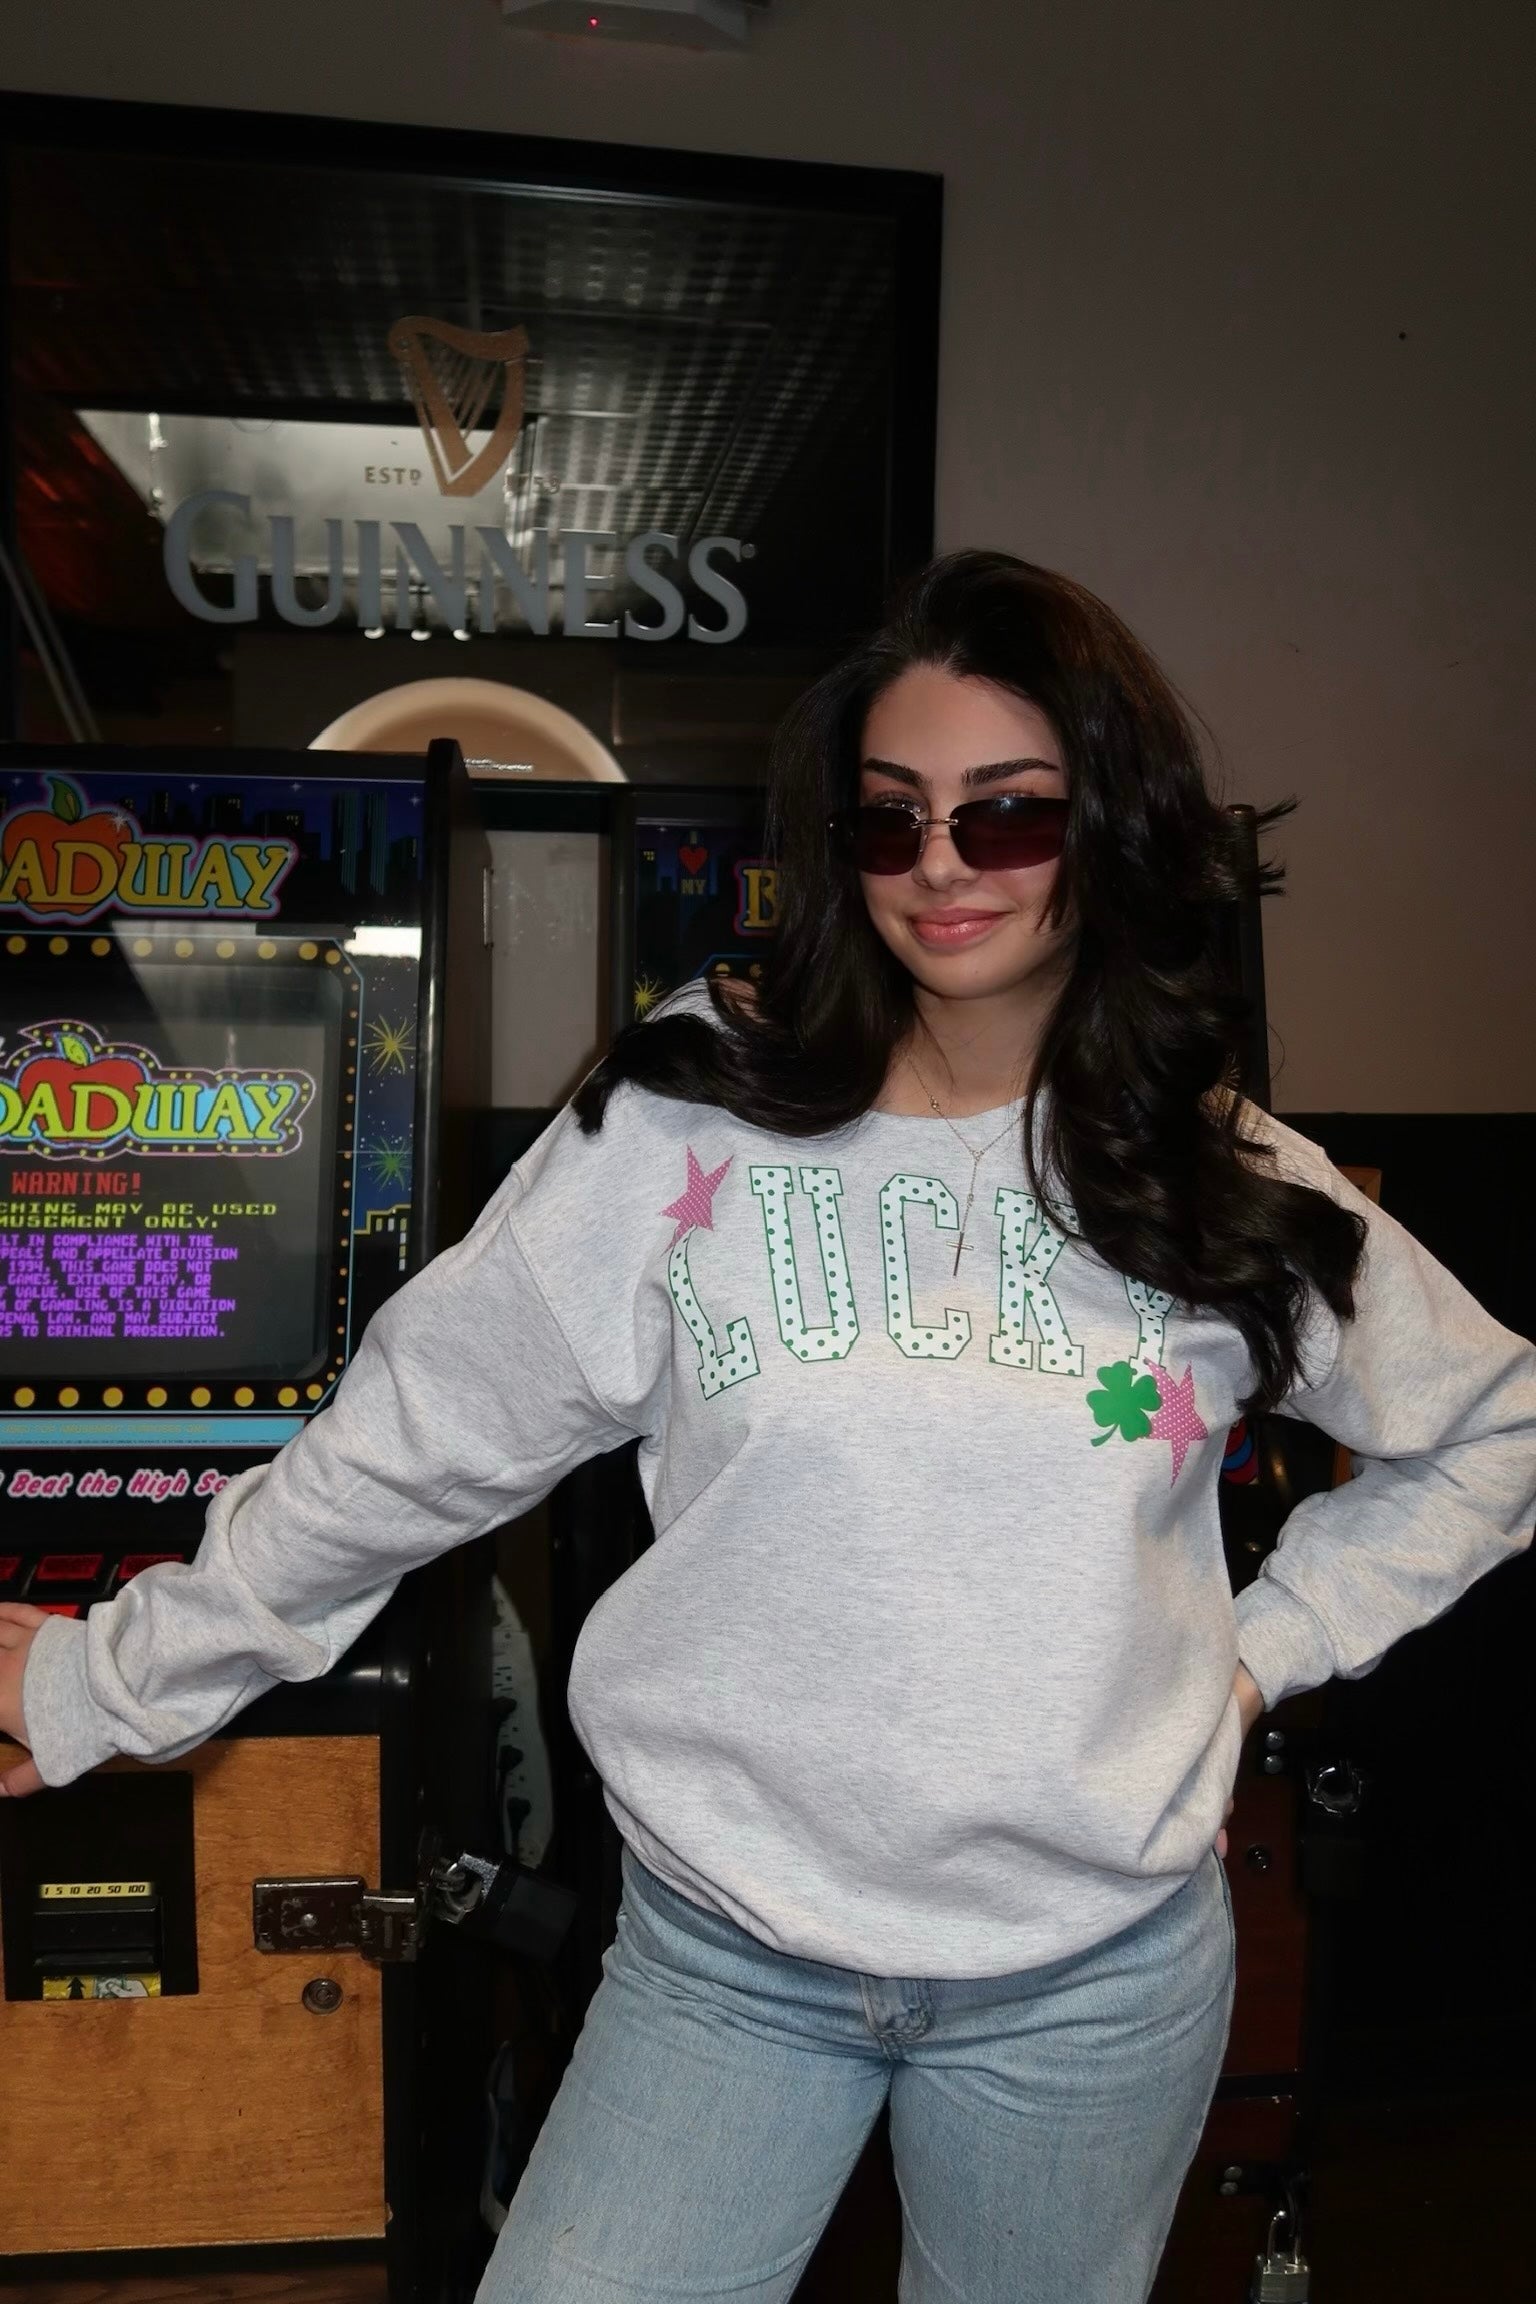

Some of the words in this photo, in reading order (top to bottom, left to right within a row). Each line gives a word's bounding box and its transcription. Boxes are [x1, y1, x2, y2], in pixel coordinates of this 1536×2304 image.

[163, 491, 748, 644] GUINNESS
[12, 1172, 141, 1195] WARNING!
[95, 1202, 143, 1214] MAY
[162, 1203, 194, 1215] BE
[212, 1203, 277, 1215] USED
[144, 1215, 218, 1229] ONLY.
[28, 1235, 45, 1248] IN
[53, 1234, 138, 1248] COMPLIANCE
[145, 1234, 180, 1248] WITH
[188, 1235, 213, 1248] THE
[52, 1247, 78, 1260] AND
[86, 1247, 162, 1260] APPELLATE
[170, 1247, 238, 1261] DIVISION
[61, 1260, 94, 1273] THIS
[102, 1260, 136, 1273] GAME
[144, 1260, 178, 1273] DOES
[186, 1260, 212, 1273] NOT
[67, 1273, 136, 1286] EXTENDED
[194, 1273, 211, 1286] OR
[668, 1165, 1177, 1400] LUCKY
[15, 1286, 66, 1299] VALUE.
[75, 1286, 101, 1299] USE
[109, 1286, 126, 1299] OF
[135, 1286, 168, 1299] THIS
[176, 1286, 211, 1299] GAME
[14, 1299, 32, 1311] OF
[40, 1299, 109, 1312] GAMBLING
[118, 1299, 134, 1311] IS
[142, 1299, 151, 1311] A
[159, 1299, 236, 1312] VIOLATION
[90, 1312, 116, 1324] AND
[124, 1312, 151, 1324] MAY
[159, 1312, 218, 1325] SUBJECT
[21, 1325, 39, 1338] TO
[47, 1325, 115, 1338] CRIMINAL
[124, 1325, 225, 1338] PROSECUTION.
[9, 1470, 73, 1498] Beat
[77, 1469, 121, 1497] the
[127, 1469, 190, 1503] High
[56, 1887, 63, 1895] 5
[70, 1886, 81, 1895] 10
[87, 1886, 101, 1895] 20
[107, 1885, 121, 1894] 50
[128, 1884, 146, 1893] 100
